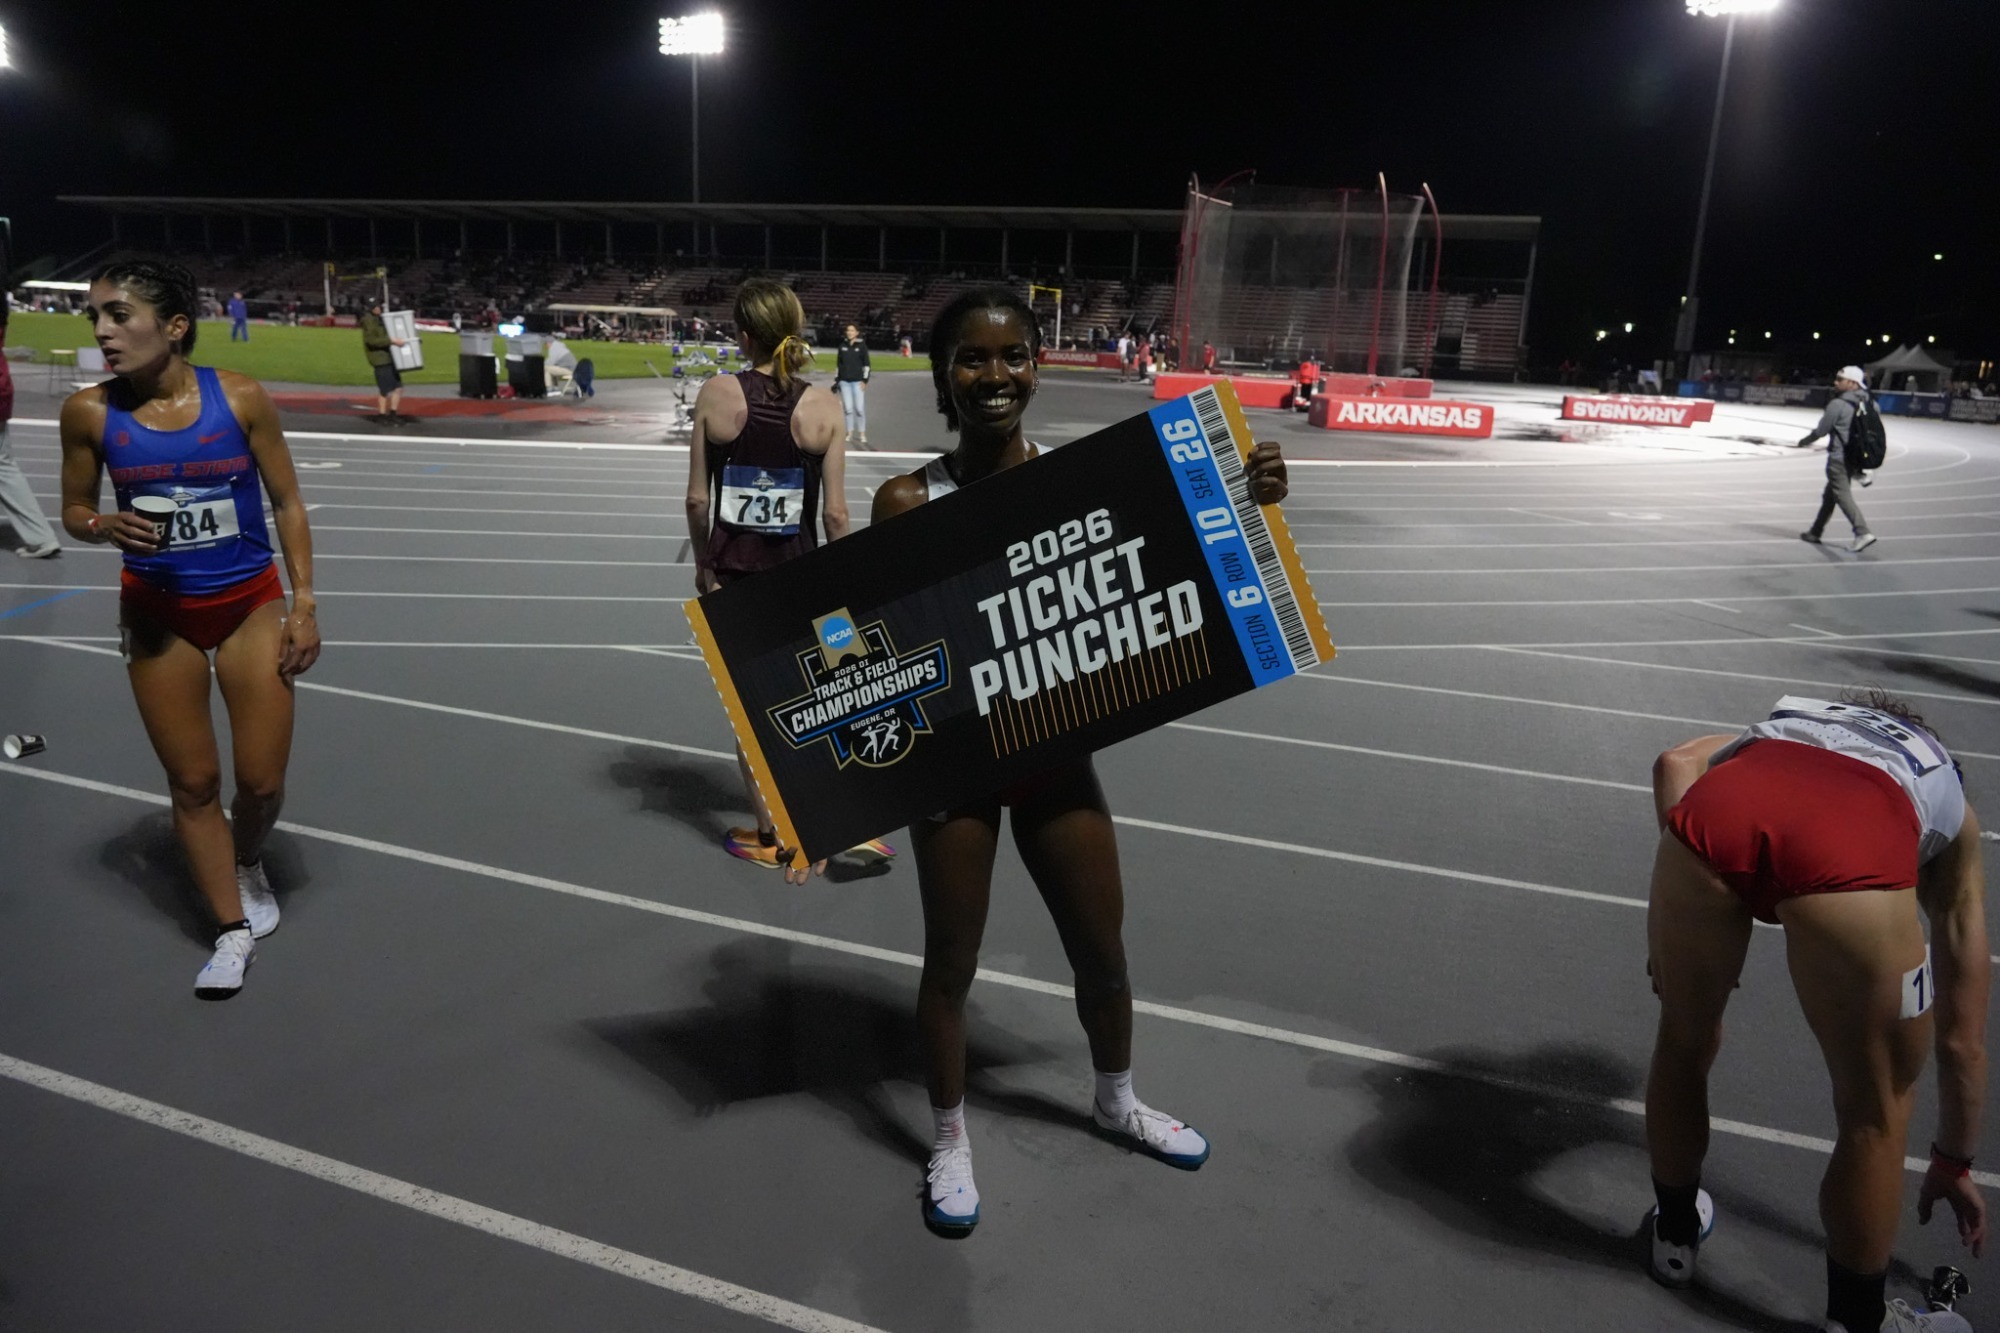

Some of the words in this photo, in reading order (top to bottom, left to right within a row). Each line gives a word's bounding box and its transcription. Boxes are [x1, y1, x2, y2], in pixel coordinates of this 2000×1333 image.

[1044, 352, 1098, 363] ARKANSAS
[1337, 402, 1482, 429] ARKANSAS
[1572, 401, 1687, 424] ARKANSAS
[1162, 418, 1208, 464] 26
[1185, 468, 1213, 499] SEAT
[168, 508, 219, 542] 84
[737, 495, 788, 524] 734
[1196, 506, 1238, 546] 10
[1006, 508, 1113, 577] 2026
[1218, 552, 1247, 583] ROW
[977, 536, 1145, 649] TICKET
[1226, 585, 1263, 608] 6
[826, 627, 854, 645] NCAA
[970, 579, 1204, 716] PUNCHED
[1243, 614, 1280, 670] SECTION
[813, 678, 852, 701] TRACK
[854, 670, 864, 686] &
[865, 657, 898, 682] FIELD
[833, 664, 857, 679] 2026
[791, 659, 938, 735] CHAMPIONSHIPS
[850, 714, 884, 732] EUGENE,
